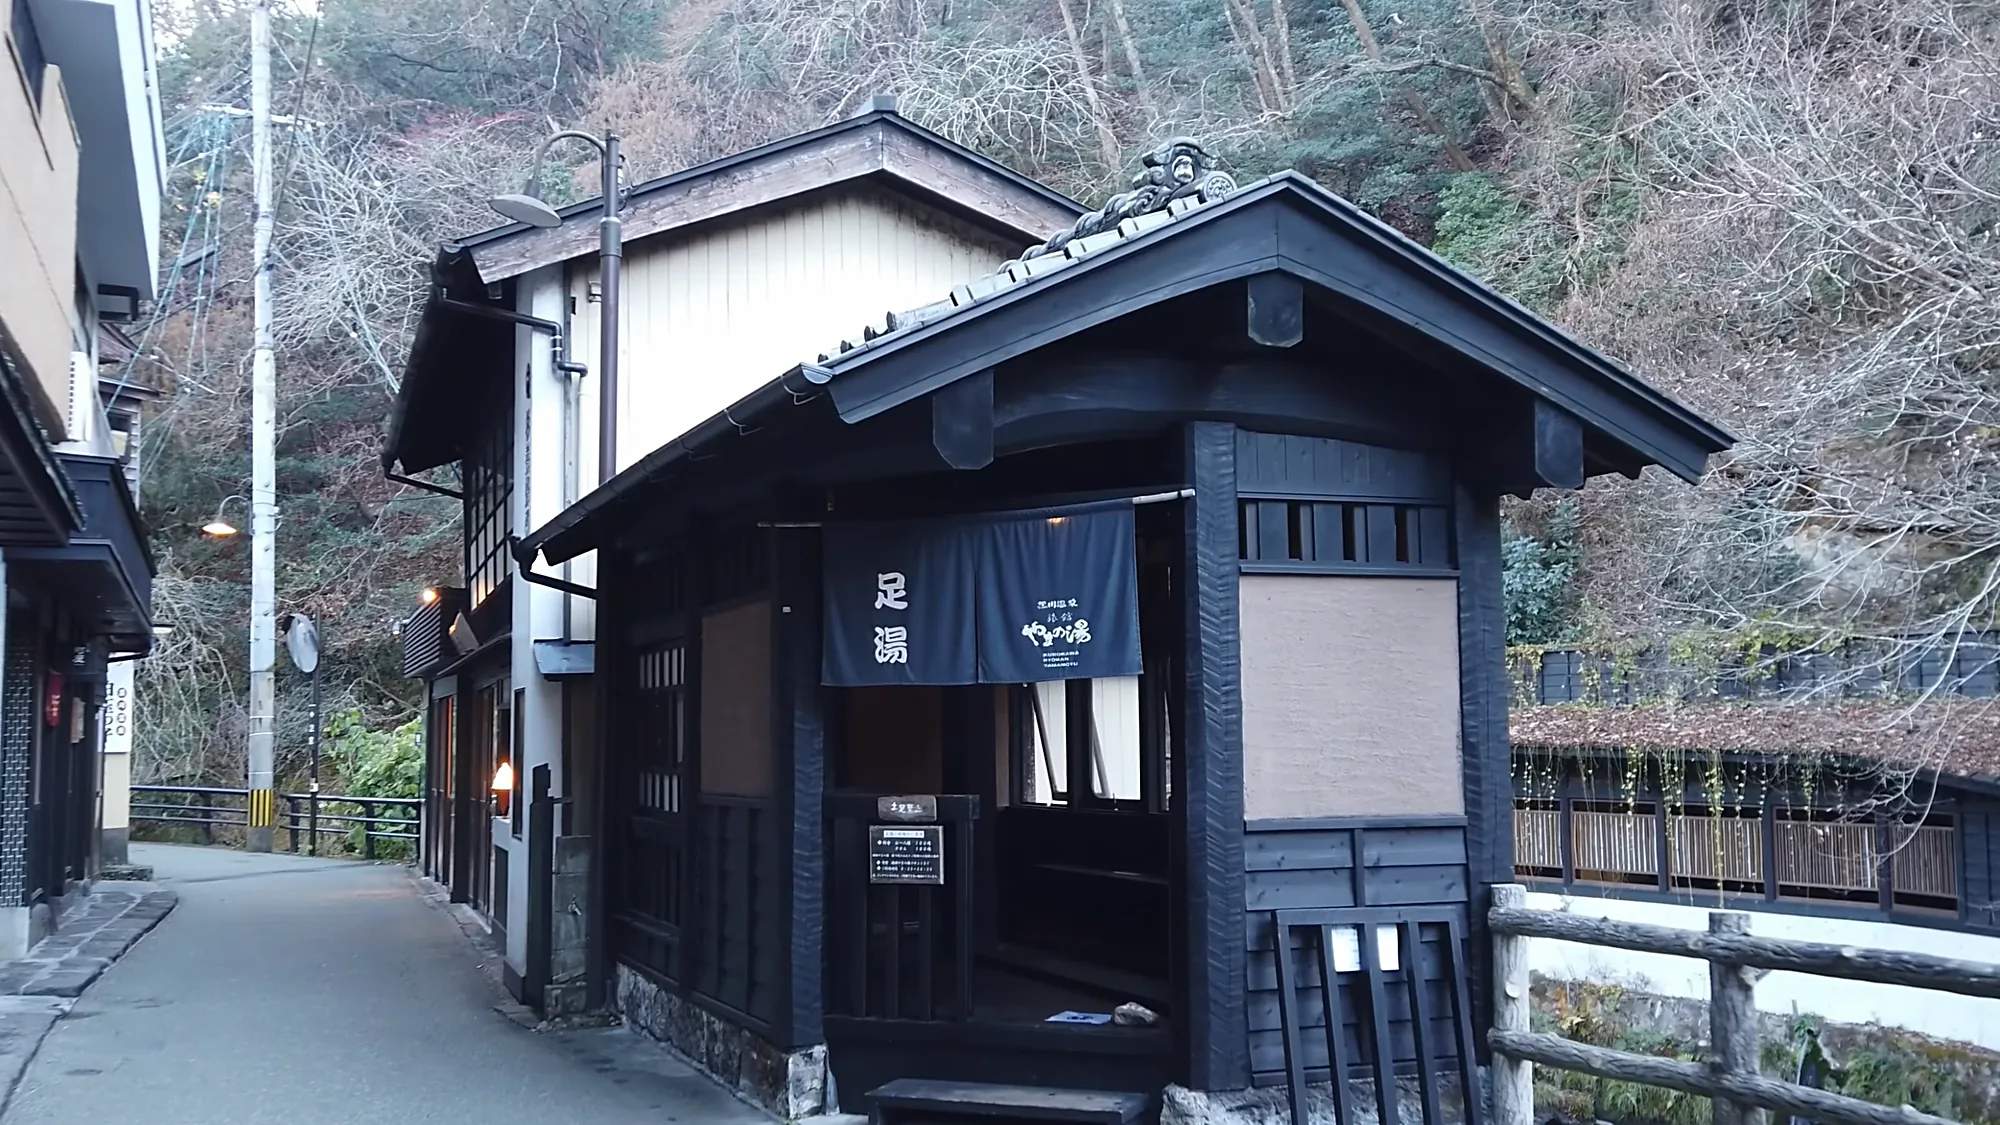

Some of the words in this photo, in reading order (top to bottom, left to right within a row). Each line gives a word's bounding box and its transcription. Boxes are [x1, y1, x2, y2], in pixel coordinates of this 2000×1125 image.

[874, 572, 908, 664] 足湯
[1022, 619, 1091, 646] やまの湯
